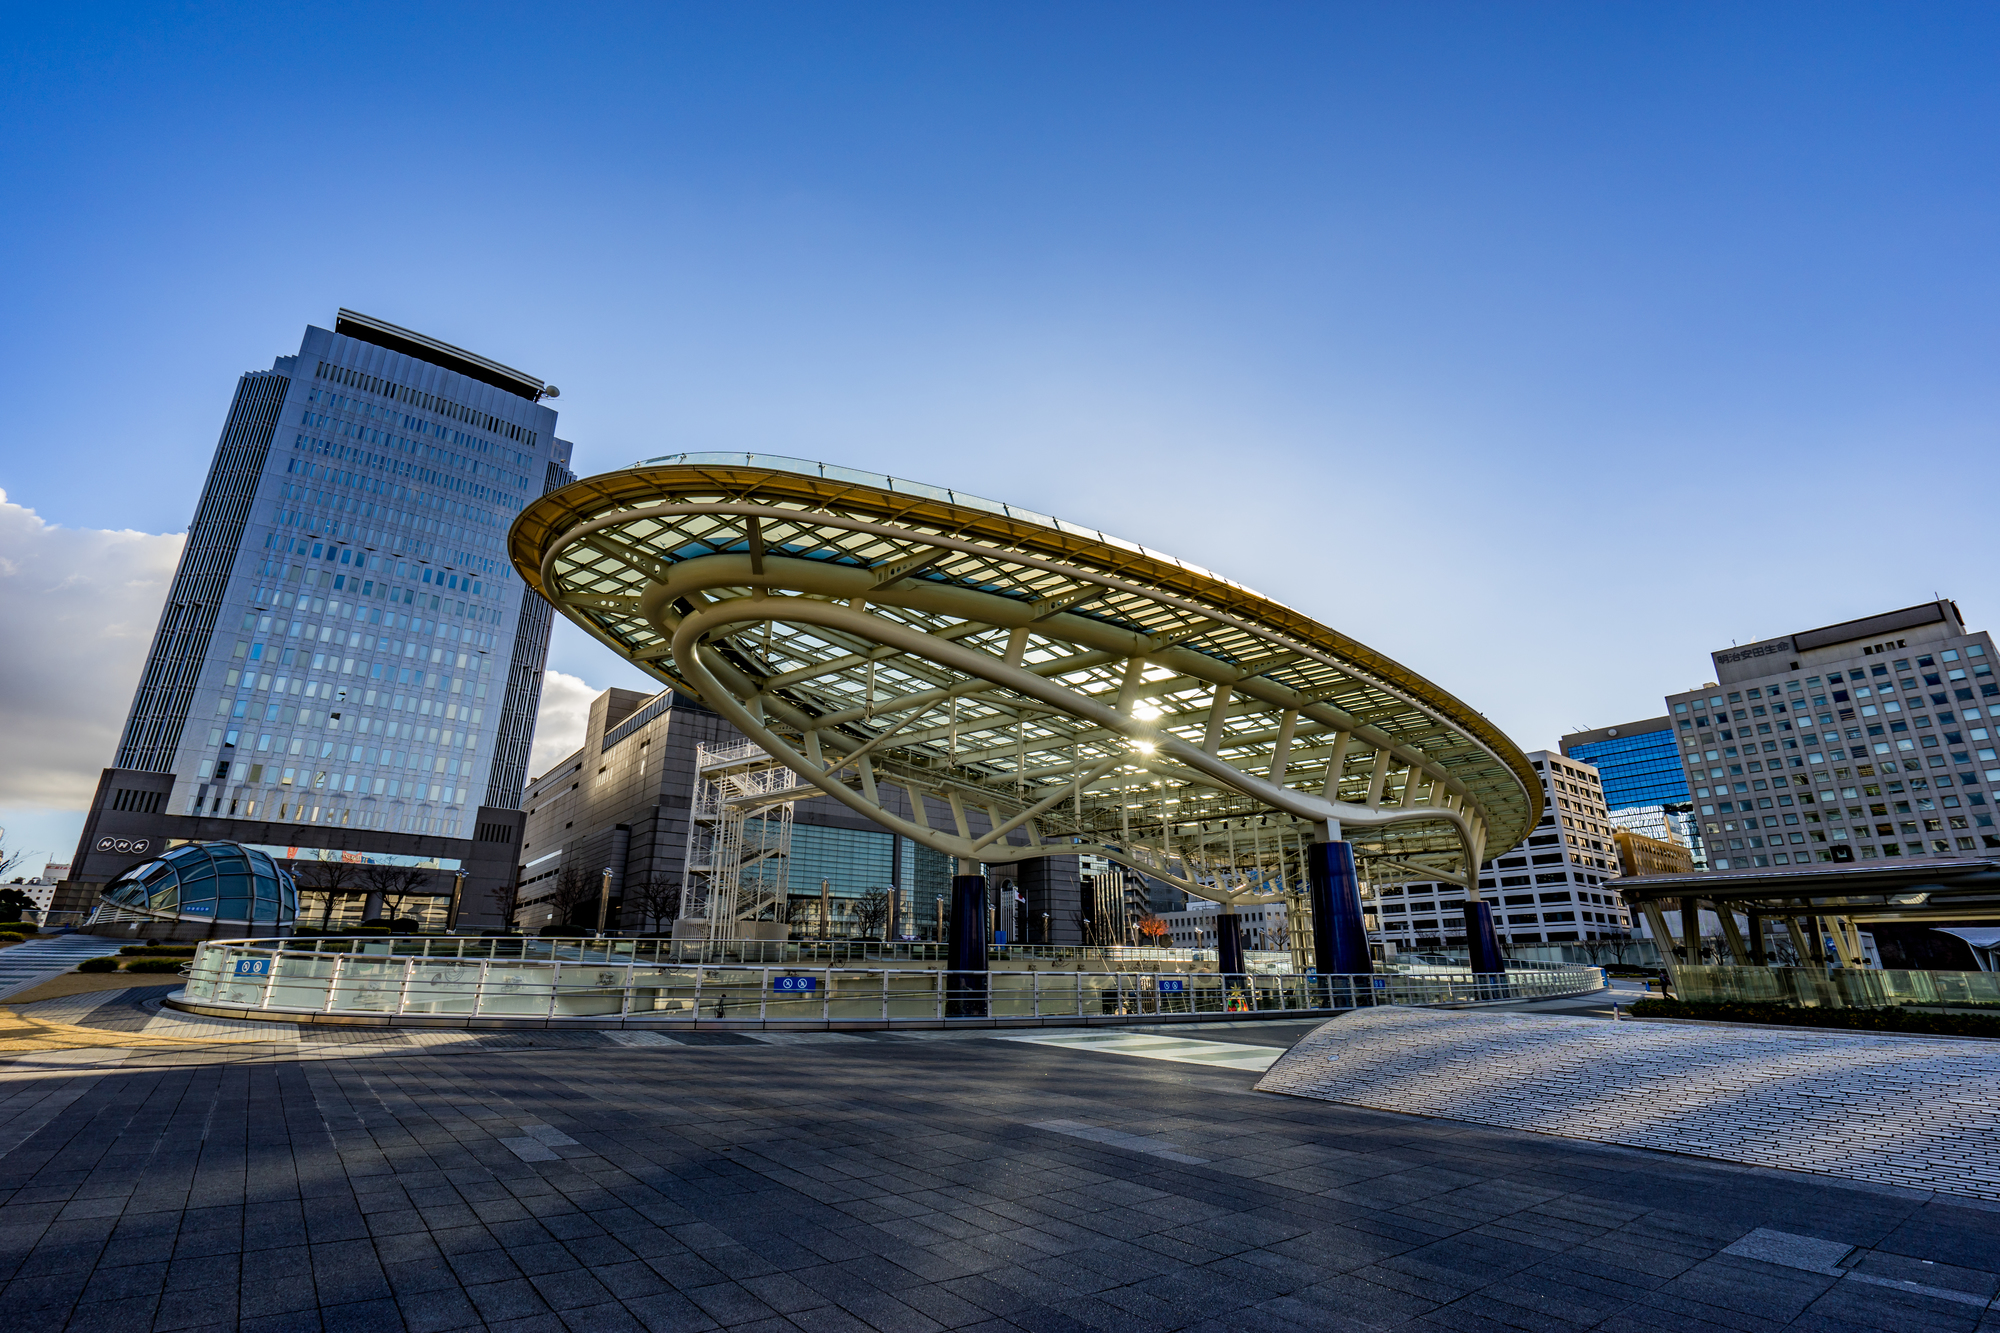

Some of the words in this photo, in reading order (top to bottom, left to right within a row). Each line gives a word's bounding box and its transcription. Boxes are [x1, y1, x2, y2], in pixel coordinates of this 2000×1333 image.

[1717, 641, 1790, 665] 明治安田生命
[100, 839, 146, 851] NHK
